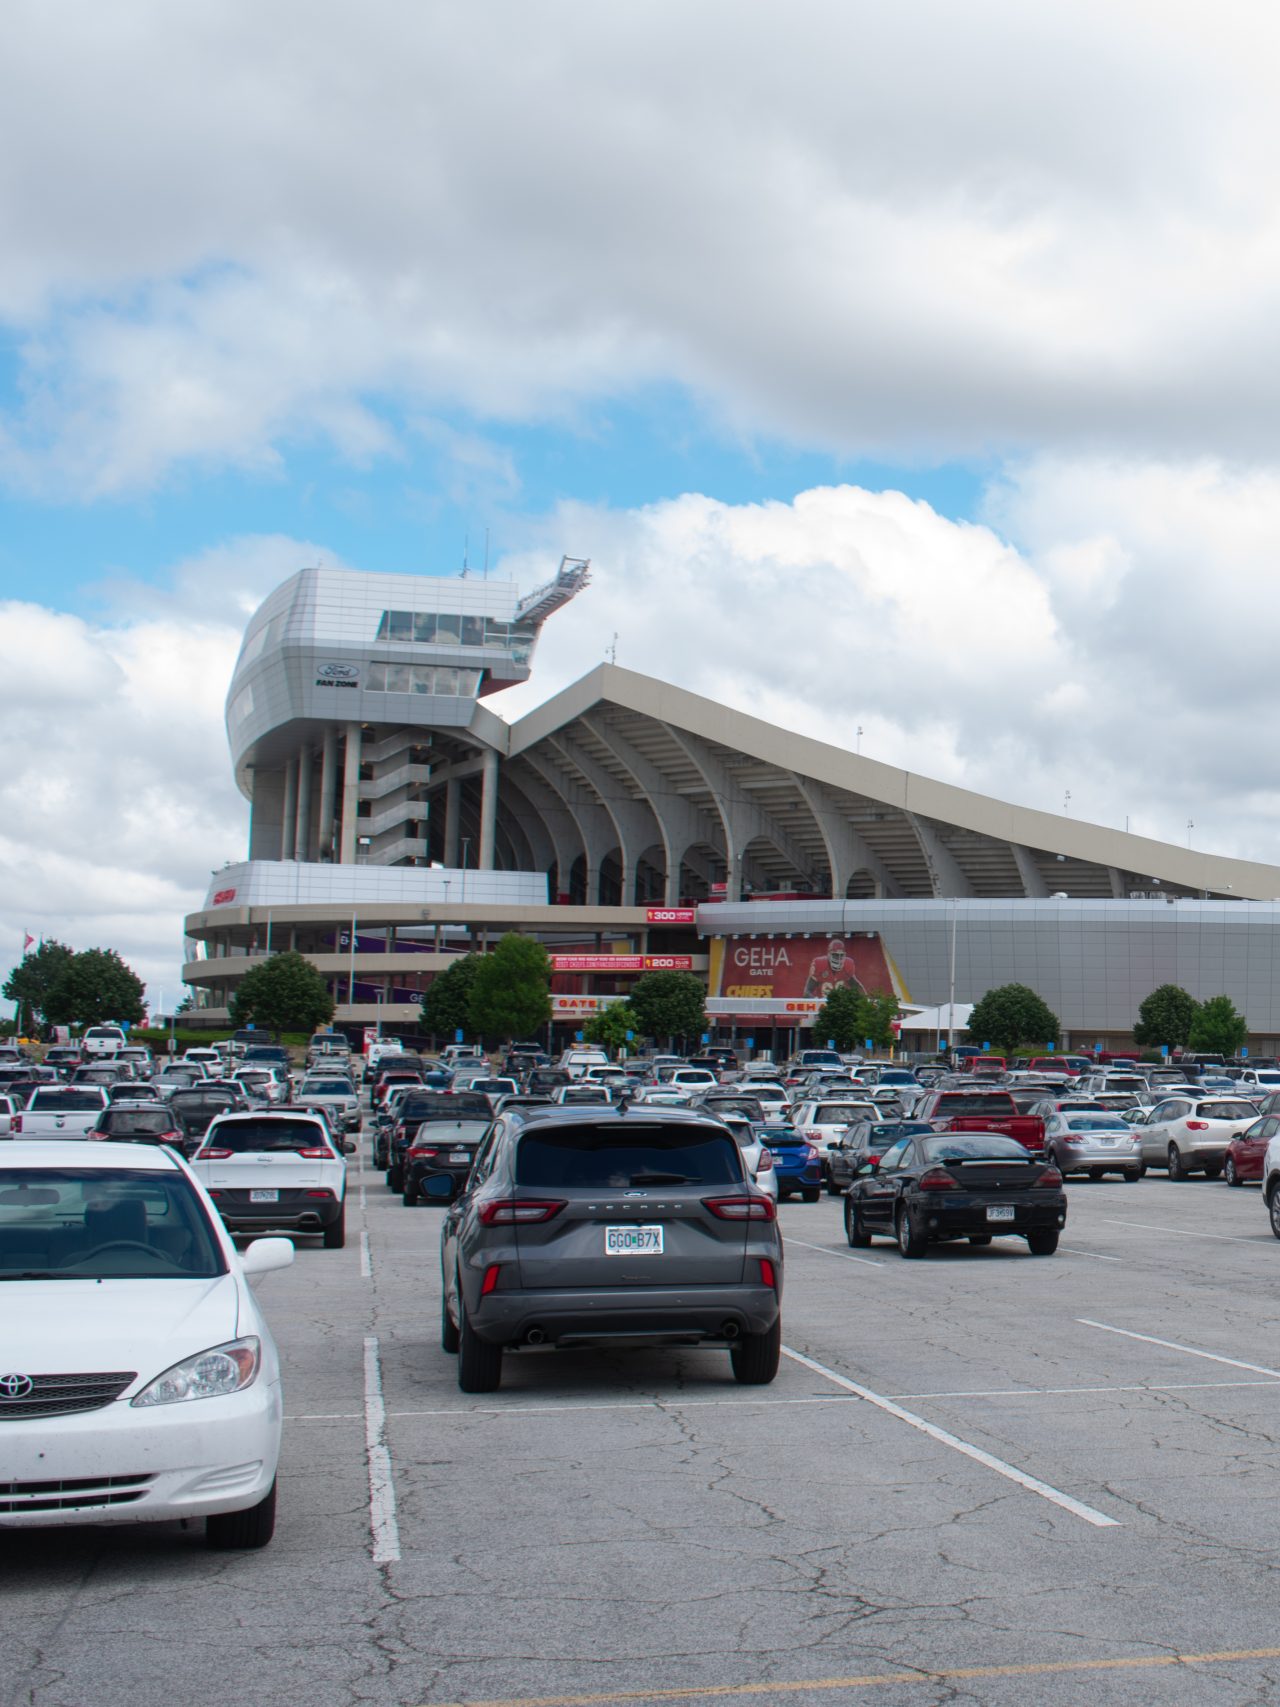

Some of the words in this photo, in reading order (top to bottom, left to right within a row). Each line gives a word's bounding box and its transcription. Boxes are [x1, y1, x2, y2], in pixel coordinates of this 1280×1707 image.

[315, 679, 335, 687] FAN
[335, 680, 359, 688] ZONE
[654, 911, 676, 920] 300
[734, 946, 789, 967] GEHA
[652, 959, 674, 967] 200
[726, 985, 774, 997] CHIEFS
[558, 999, 597, 1009] GATE
